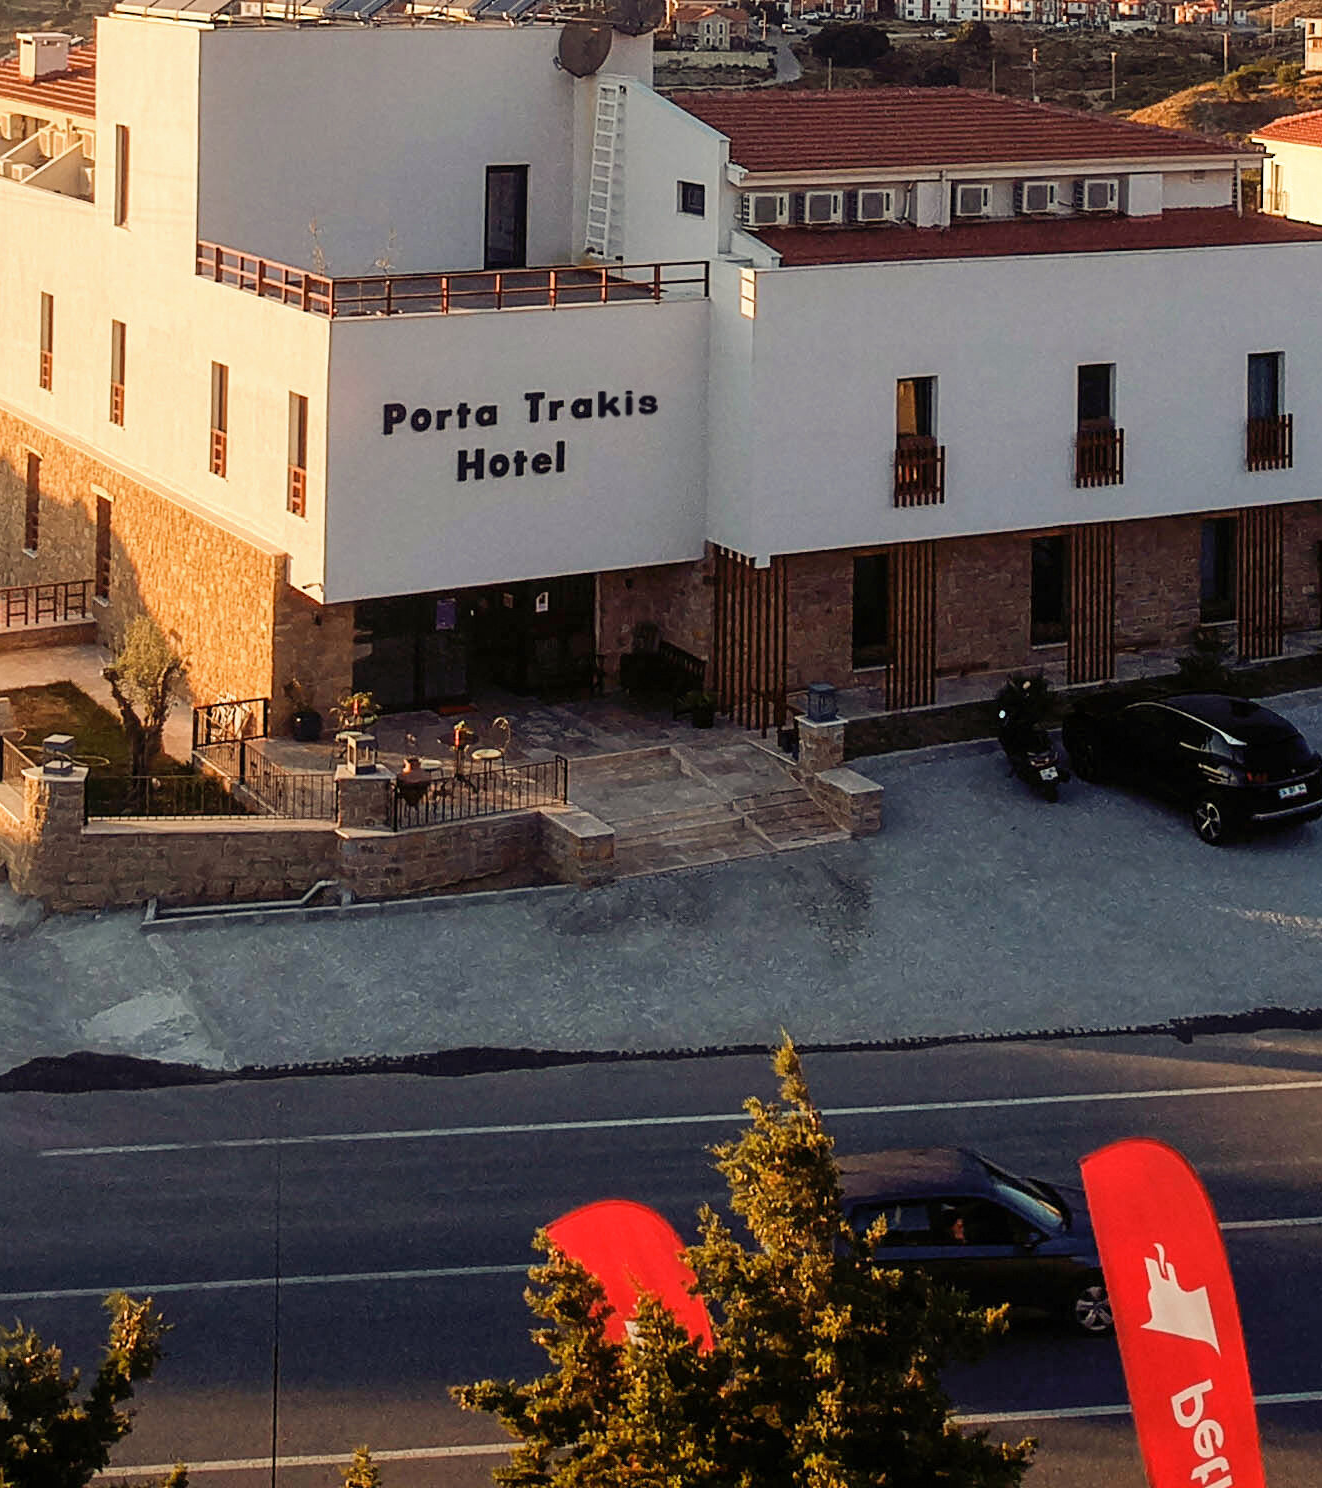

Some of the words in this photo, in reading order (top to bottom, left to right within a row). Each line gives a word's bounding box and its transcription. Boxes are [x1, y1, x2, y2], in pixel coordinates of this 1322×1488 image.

[382, 402, 498, 435] Porta
[524, 390, 659, 423] Trakis
[456, 440, 566, 482] Hotel
